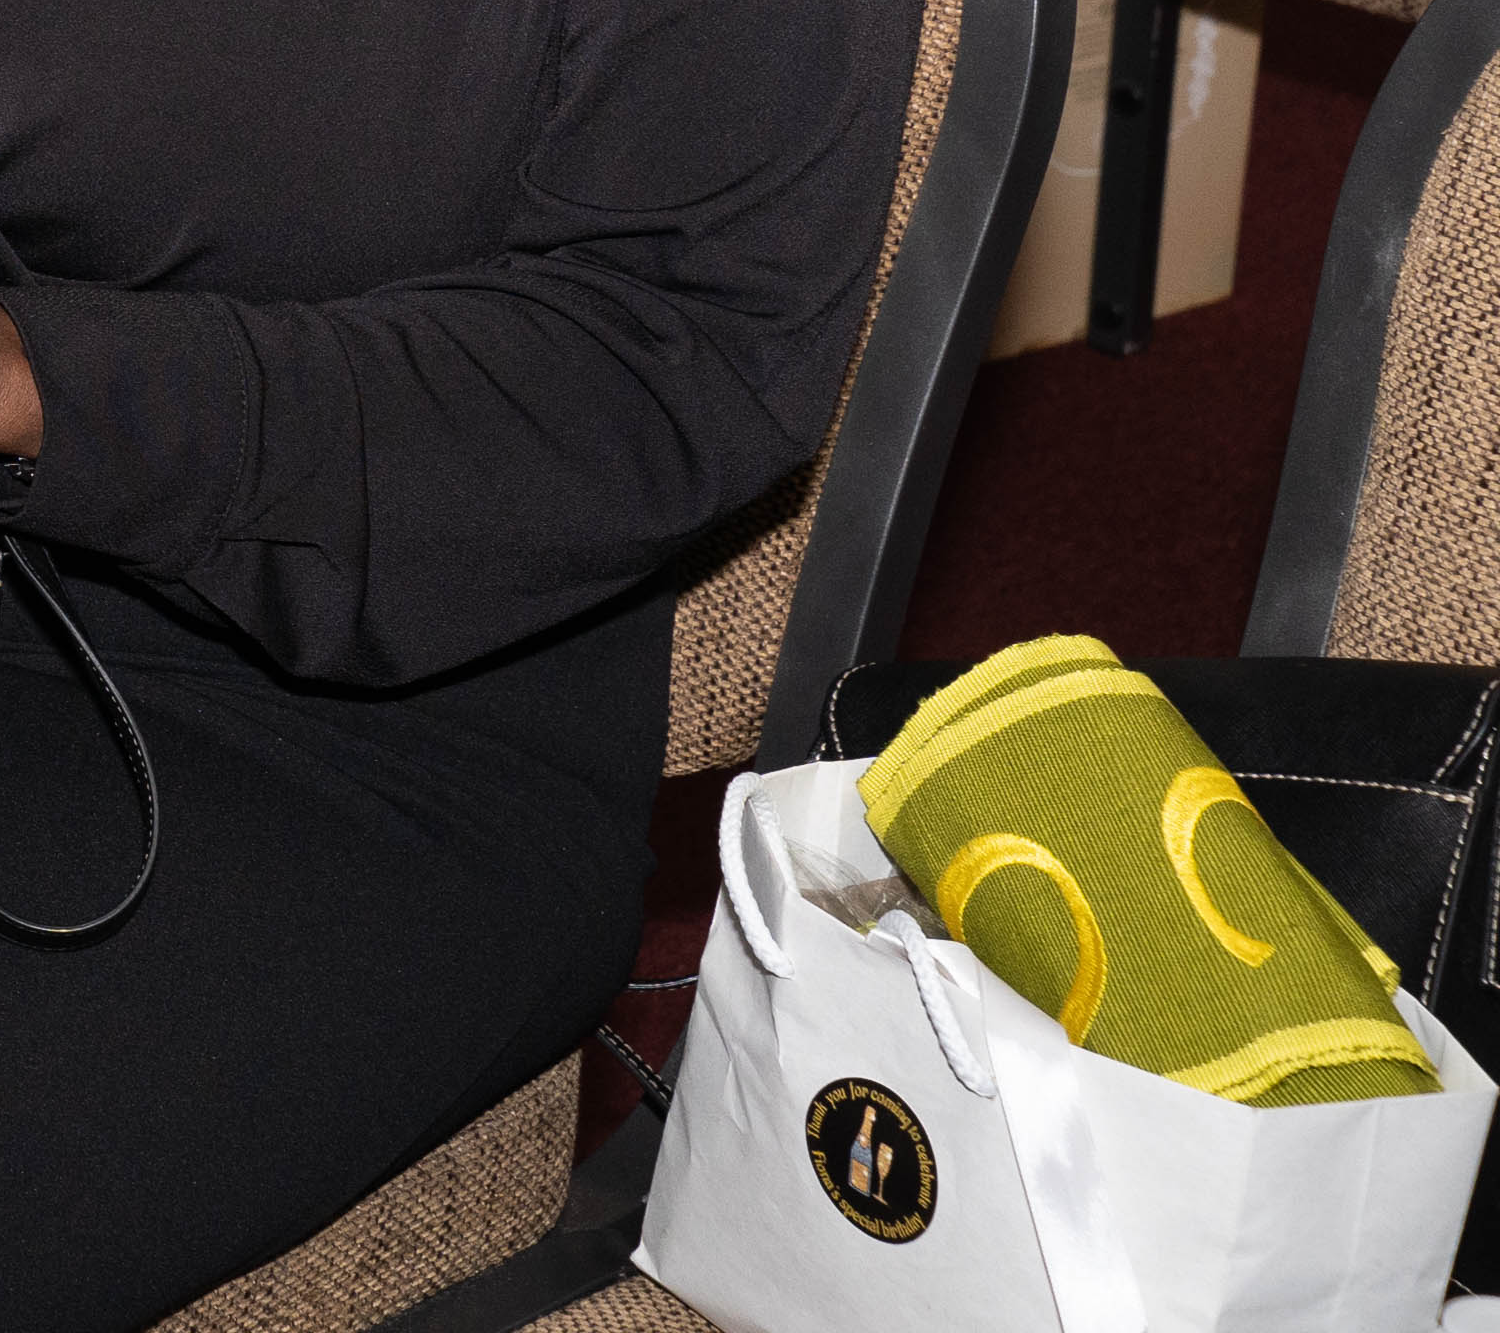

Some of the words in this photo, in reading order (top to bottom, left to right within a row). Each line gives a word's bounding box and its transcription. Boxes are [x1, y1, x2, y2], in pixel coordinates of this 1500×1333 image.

[807, 1101, 828, 1139] Thank
[825, 1086, 847, 1109] you
[849, 1081, 869, 1100] for
[870, 1088, 912, 1129] coming
[908, 1125, 922, 1142] to
[915, 1144, 935, 1209] celebrate
[811, 1150, 841, 1200] Fiona's
[839, 1198, 881, 1236] special
[880, 1212, 927, 1238] birthday
